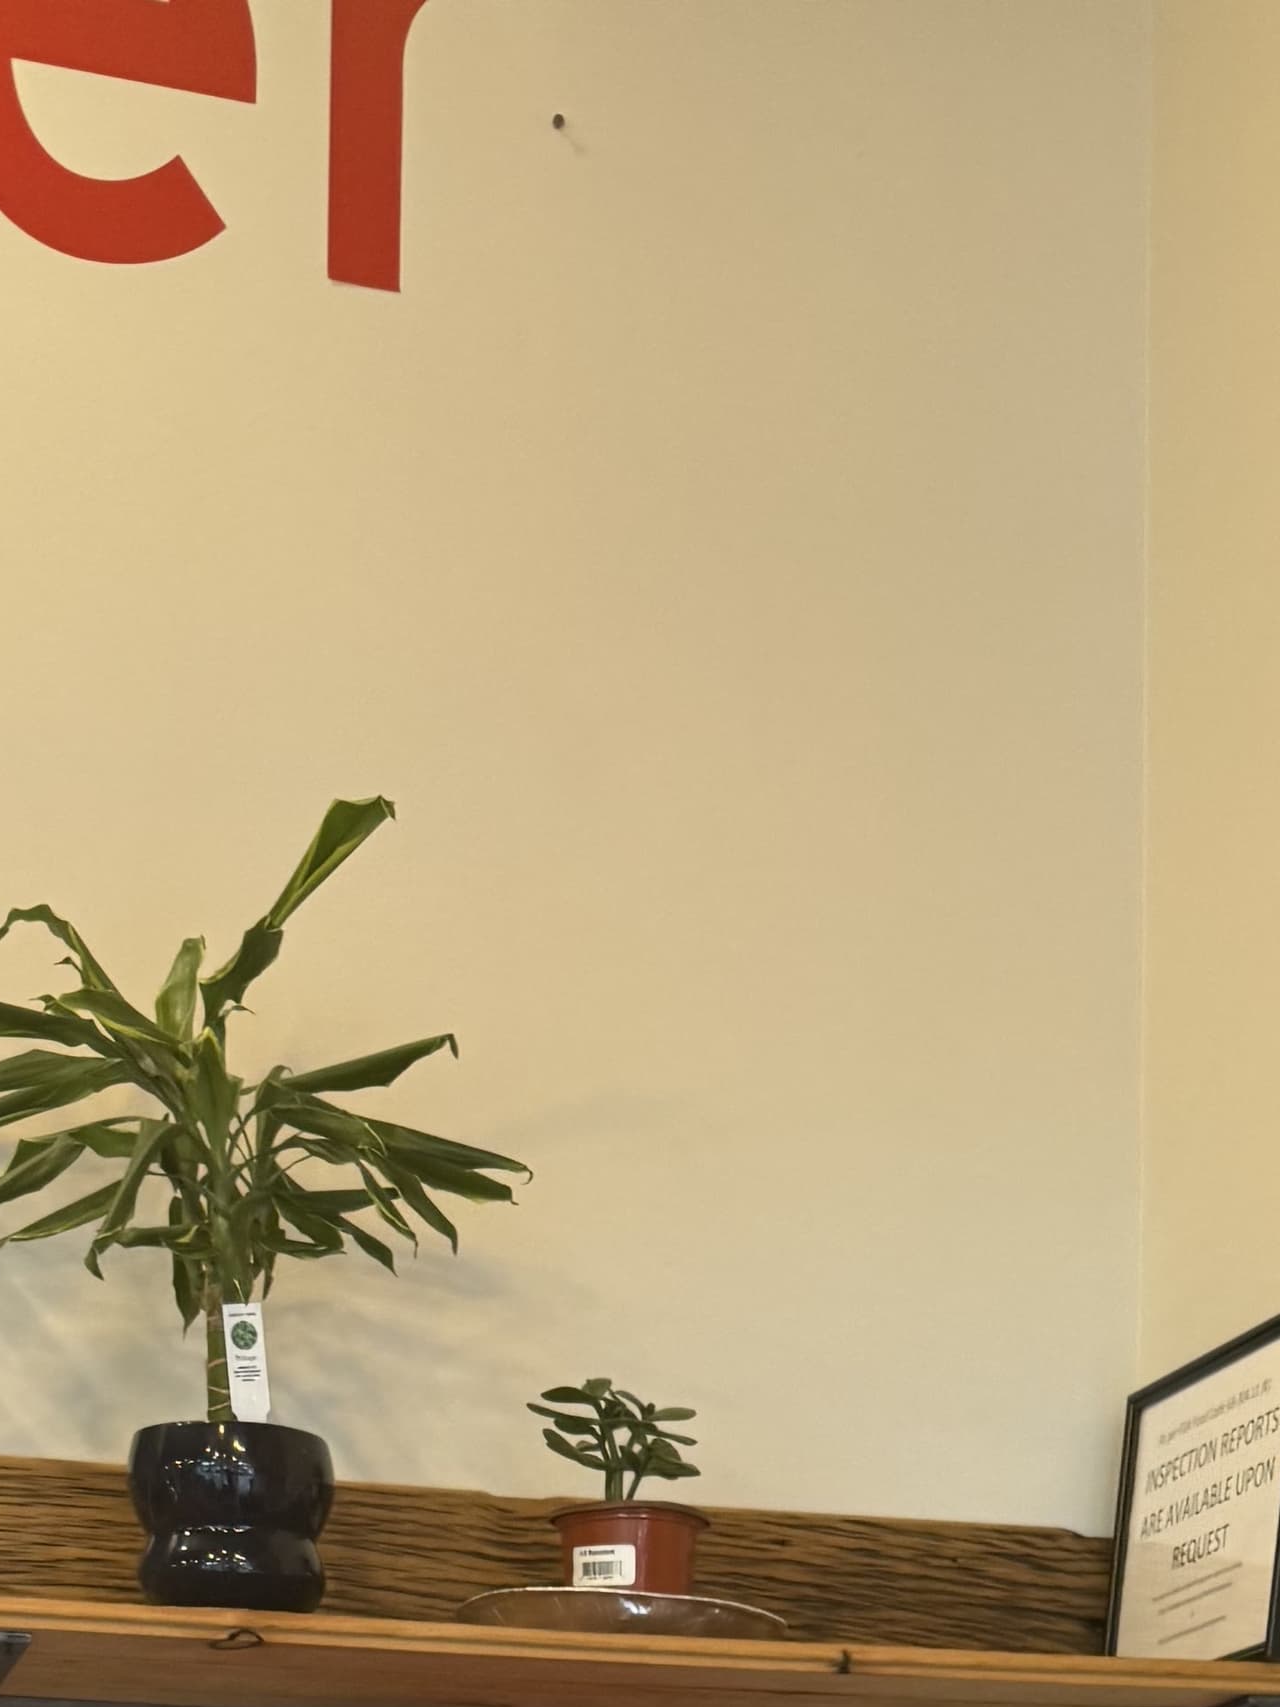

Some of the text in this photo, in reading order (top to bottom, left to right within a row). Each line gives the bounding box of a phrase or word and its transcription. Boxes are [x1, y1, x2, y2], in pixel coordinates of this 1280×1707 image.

[1145, 1437, 1218, 1494] INSPECTION
[1220, 1407, 1280, 1457] REPORTS
[1140, 1456, 1276, 1539] ARE AVAILABLE UPON
[1171, 1523, 1229, 1570] REQUEST
